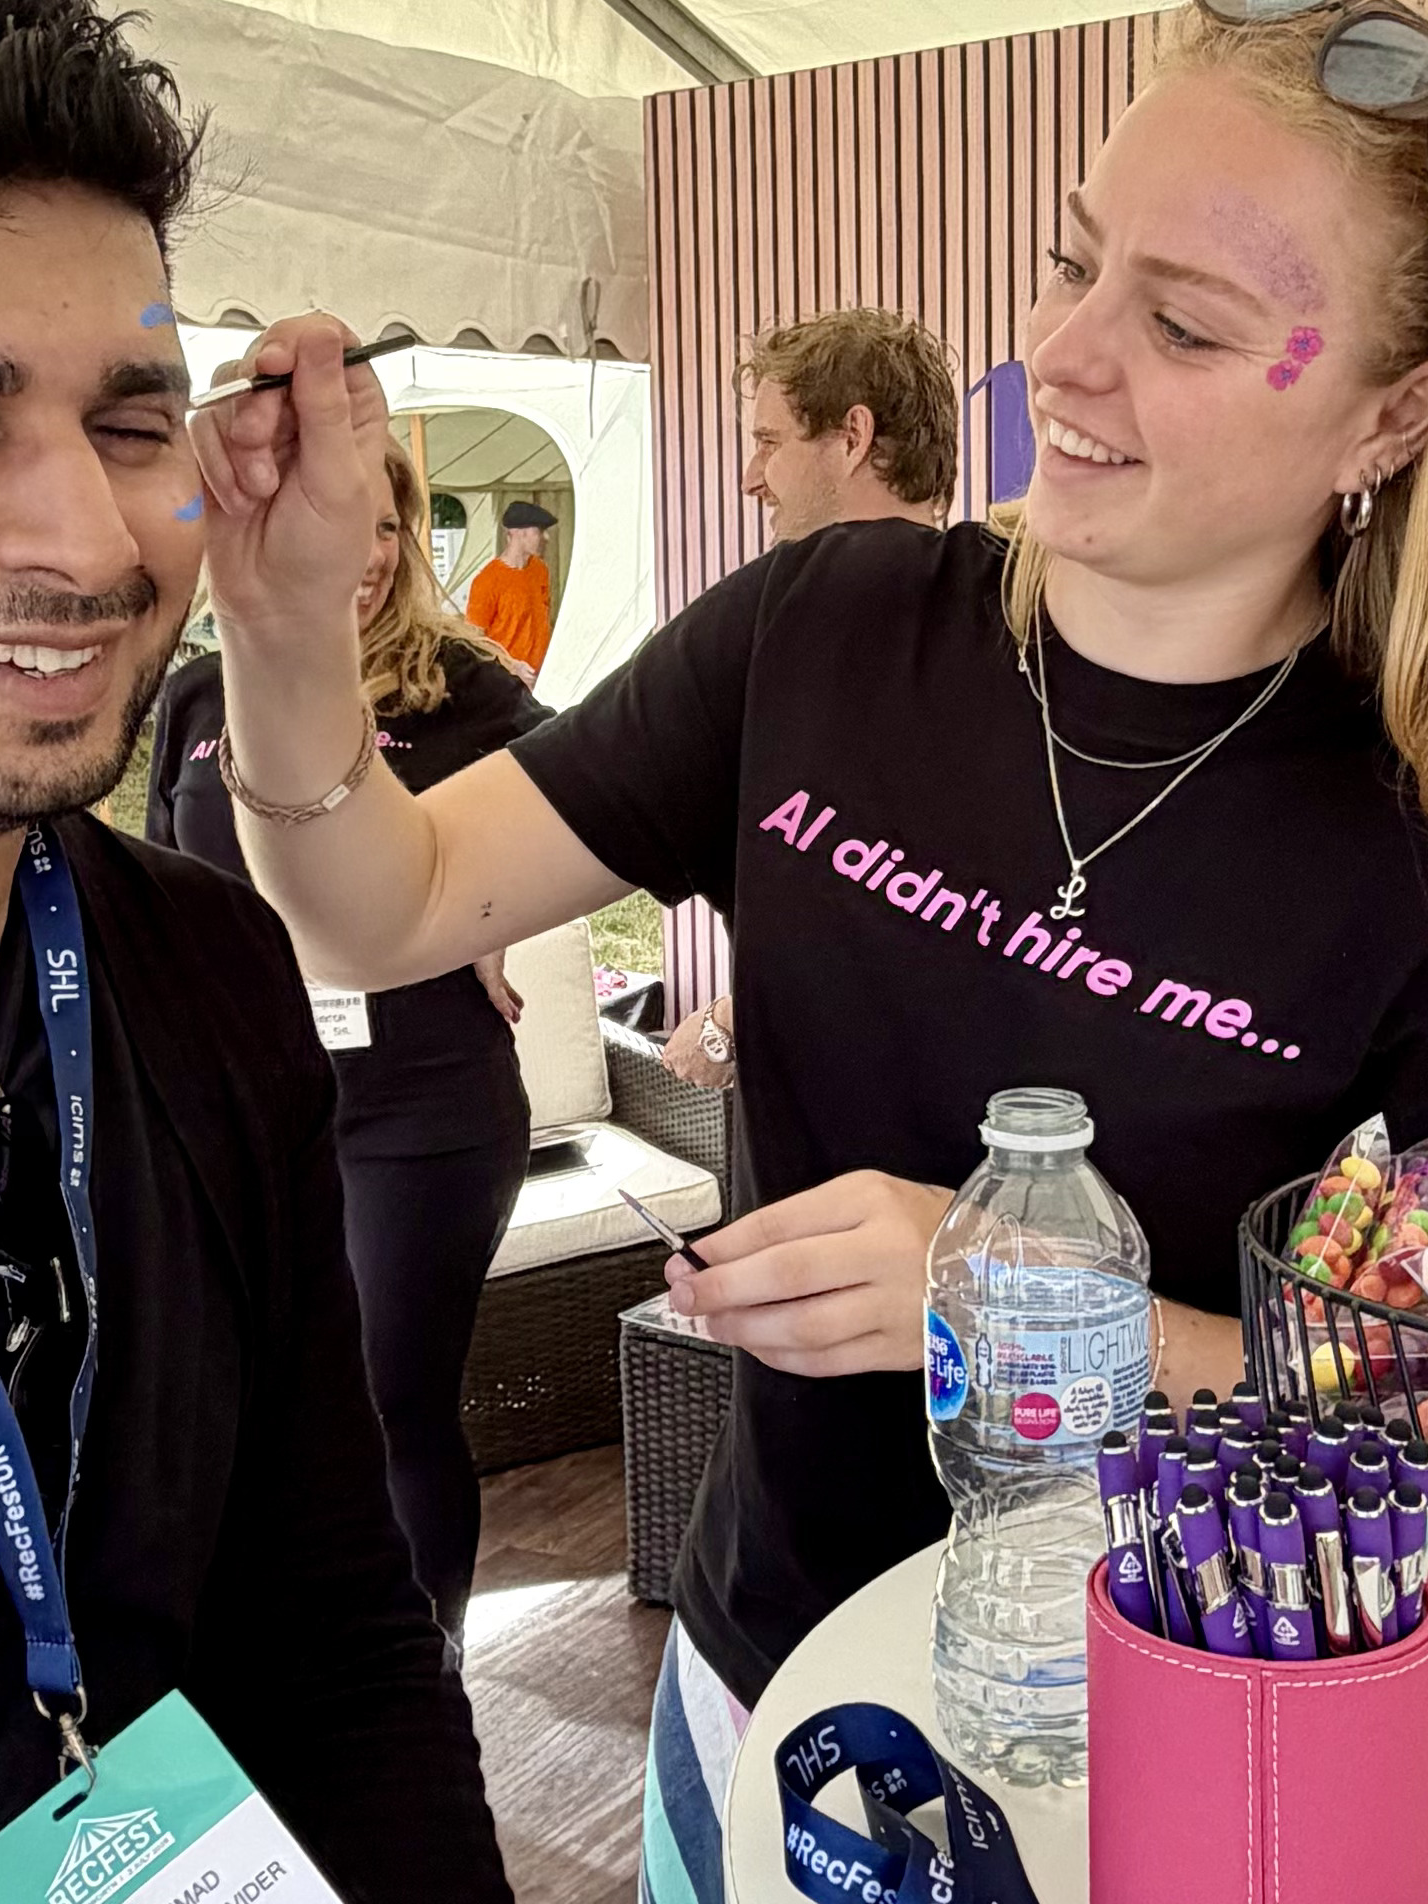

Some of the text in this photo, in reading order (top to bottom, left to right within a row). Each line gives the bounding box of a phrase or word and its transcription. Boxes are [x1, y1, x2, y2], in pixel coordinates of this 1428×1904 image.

[189, 739, 217, 761] AI
[759, 789, 1301, 1060] AI didn't hire me...
[46, 947, 81, 1013] SHL
[936, 1355, 965, 1389] Life
